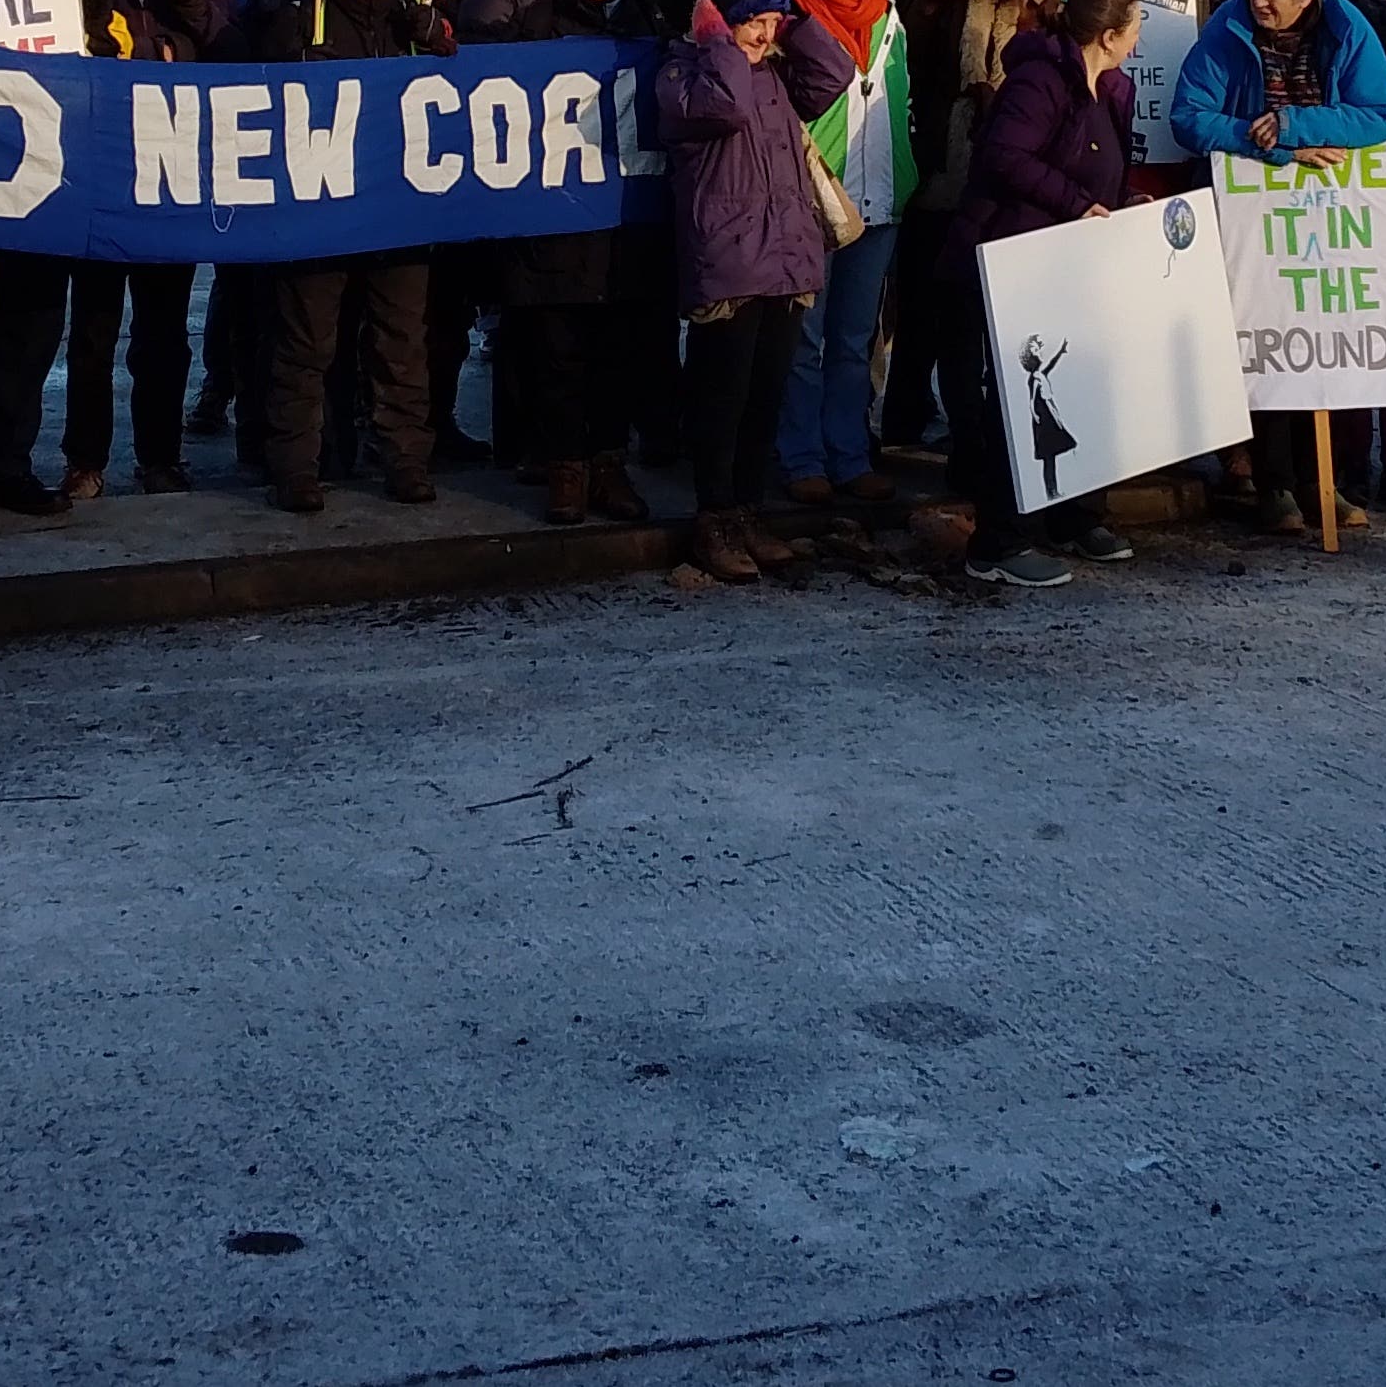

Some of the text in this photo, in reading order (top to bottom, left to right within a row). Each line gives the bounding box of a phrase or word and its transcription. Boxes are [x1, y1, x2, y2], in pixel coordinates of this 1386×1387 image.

[1127, 67, 1165, 86] THE
[132, 77, 361, 206] NEW
[400, 66, 669, 195] COAL
[1289, 189, 1341, 207] SAFE
[1263, 205, 1373, 256] IT IN
[1278, 267, 1380, 313] THE
